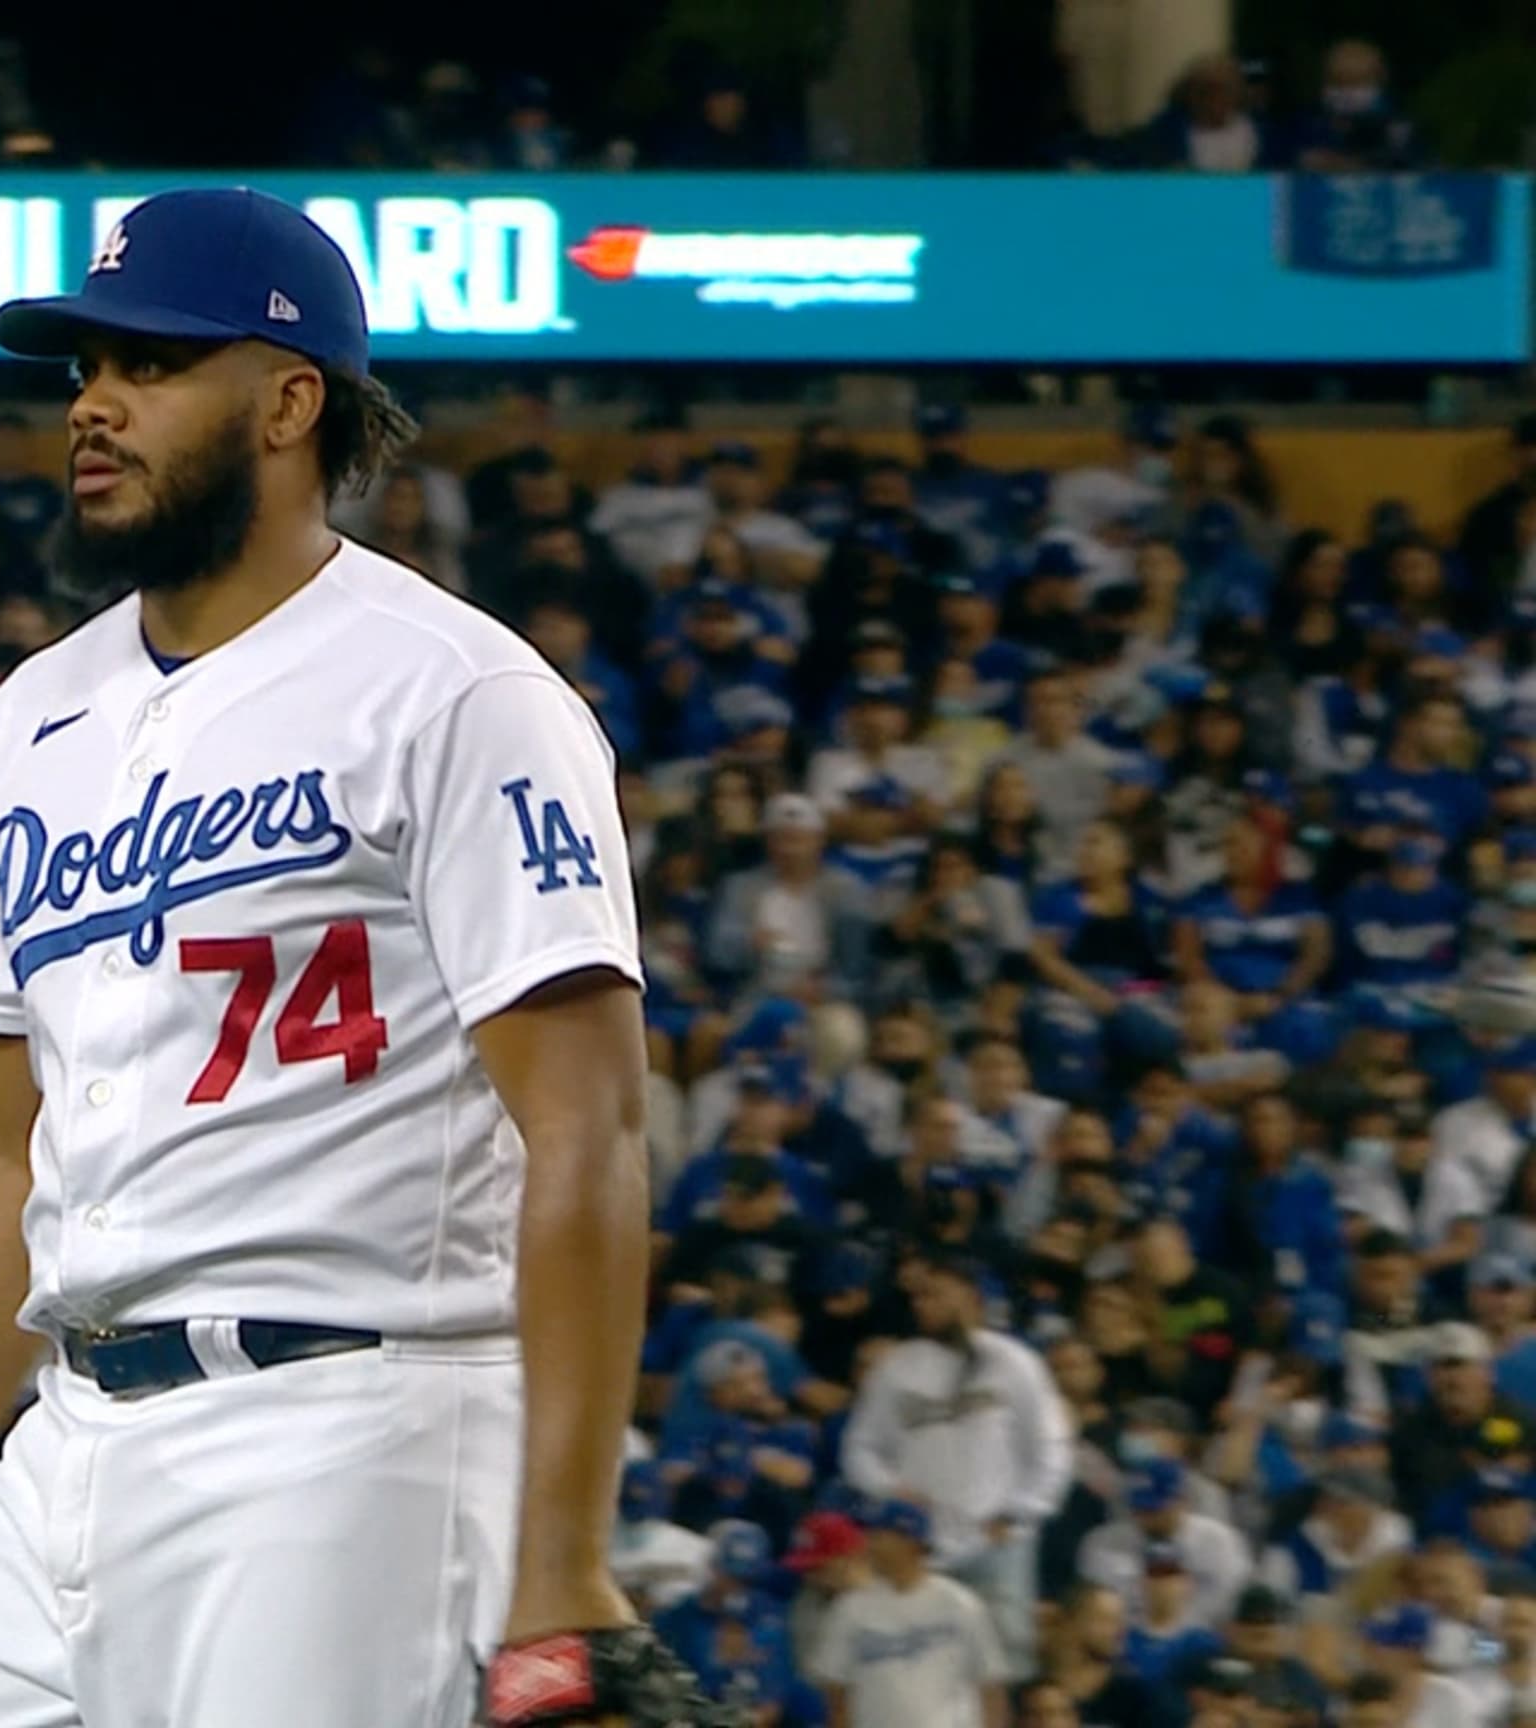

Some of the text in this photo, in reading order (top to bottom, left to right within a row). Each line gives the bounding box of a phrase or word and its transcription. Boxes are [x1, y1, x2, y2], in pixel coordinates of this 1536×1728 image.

[302, 196, 560, 334] ARD
[500, 777, 602, 894] LA
[178, 918, 389, 1107] 74
